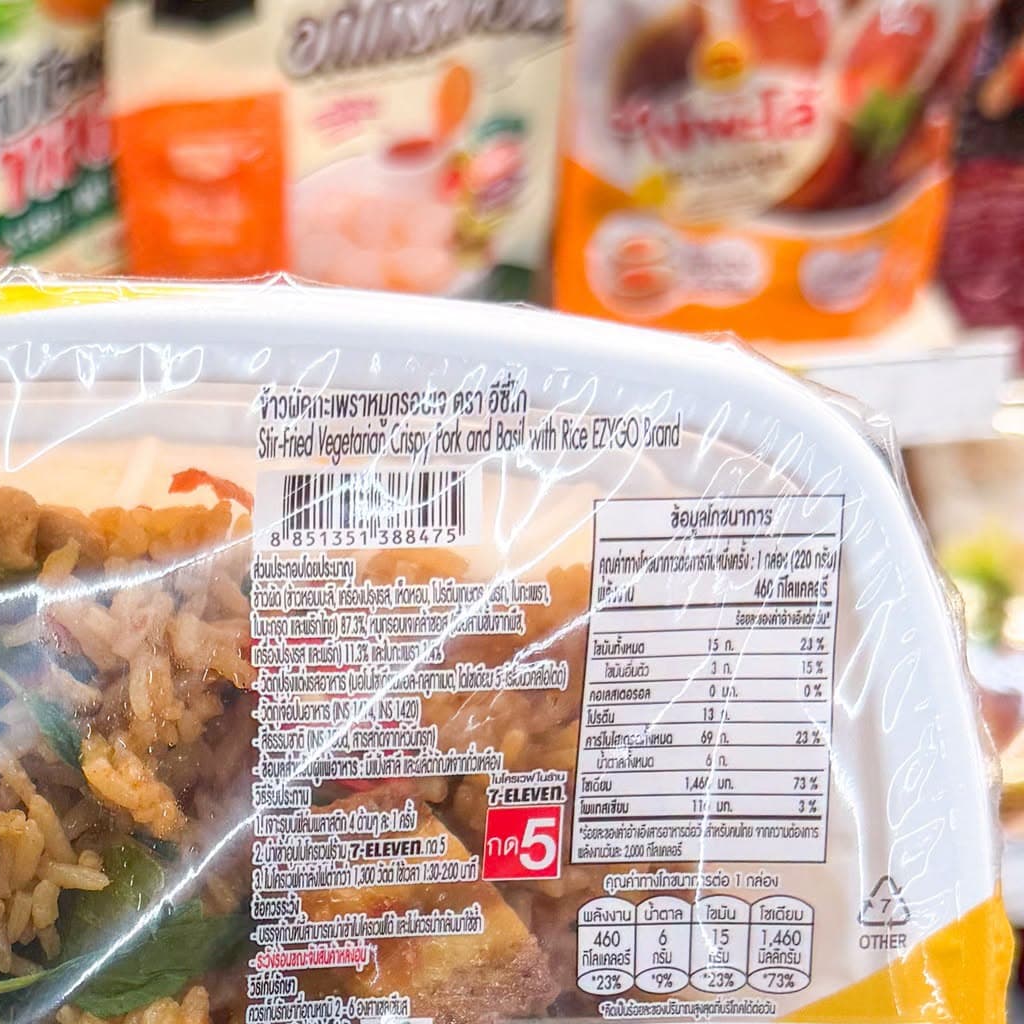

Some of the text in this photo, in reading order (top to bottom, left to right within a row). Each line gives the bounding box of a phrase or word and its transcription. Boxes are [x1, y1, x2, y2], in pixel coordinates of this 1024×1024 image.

[261, 387, 447, 425] ข้าวผัดกะเพราหมูกรอบเจ
[452, 390, 482, 416] ตรา
[259, 412, 680, 466] Stir-Fried Vegetarian Crispy Pork and Basil with Rice EZYGO Brand
[671, 503, 772, 537] ข้อมูลโภชนาการ
[270, 527, 457, 547] 8 851351 388475
[253, 554, 354, 579] ส่วนประกอบโดยประมาณ
[764, 546, 788, 570] กล่อง
[790, 549, 811, 572] (220
[253, 583, 282, 608] ข้าวผัด
[345, 643, 369, 663] 11.3%
[708, 638, 719, 651] 15
[589, 688, 651, 702] คอเลสเตอรอล
[709, 684, 716, 697] 0
[396, 698, 419, 721] 1420)
[587, 708, 714, 724] โปรตีน 13
[701, 731, 713, 744] 69
[582, 777, 612, 792] โซเดียม
[399, 801, 415, 829] ครั้ง
[487, 817, 556, 870] กด 5
[624, 844, 645, 858] 2,000
[355, 866, 375, 887] 1,300
[461, 859, 476, 879] นาที
[736, 873, 742, 887] 1
[746, 872, 779, 888] กล่อง
[583, 908, 631, 922] พลังงาน
[644, 903, 683, 921] น้ำตาล
[707, 905, 736, 920] ไขมัน
[760, 907, 804, 921] โซเดียม
[880, 899, 891, 913] 7
[593, 930, 621, 948] 460
[658, 929, 668, 946] 6
[712, 929, 729, 946] 15
[761, 929, 802, 947] 1,460
[859, 934, 907, 949] OTHER
[582, 948, 631, 966] กิโลแคลอรี
[652, 951, 673, 965] กรัม
[758, 949, 802, 965] มิลลิกรัม
[335, 1001, 340, 1016] 2
[349, 999, 354, 1015] 6
